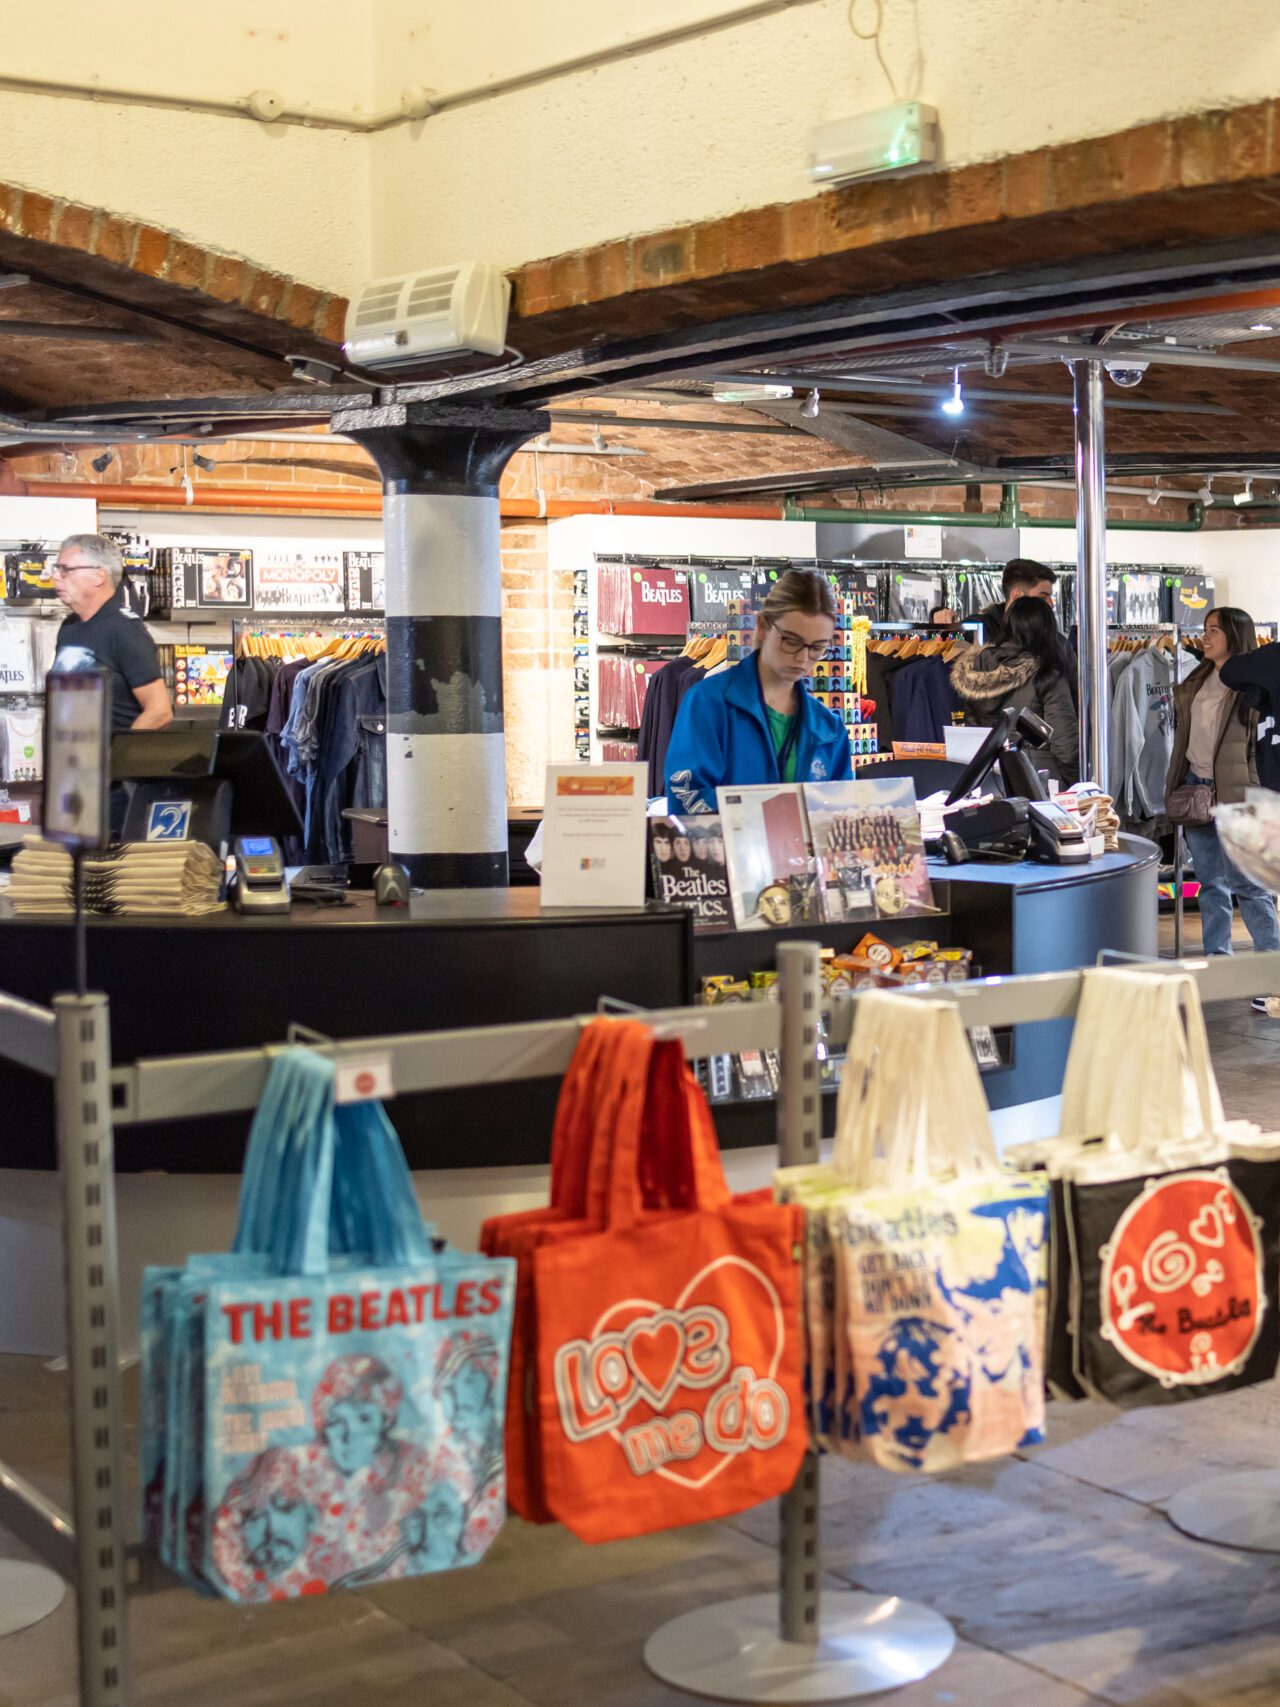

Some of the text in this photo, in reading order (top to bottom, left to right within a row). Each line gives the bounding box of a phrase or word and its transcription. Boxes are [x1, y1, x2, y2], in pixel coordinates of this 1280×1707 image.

[263, 569, 338, 582] MONOPOLY
[641, 581, 682, 606] BEATLES
[704, 582, 745, 606] BEATLES
[0, 670, 25, 684] ATLES
[682, 867, 700, 880] The
[661, 874, 728, 898] Beatles
[220, 1278, 503, 1346] THE BEATLES
[621, 1365, 790, 1477] me do
